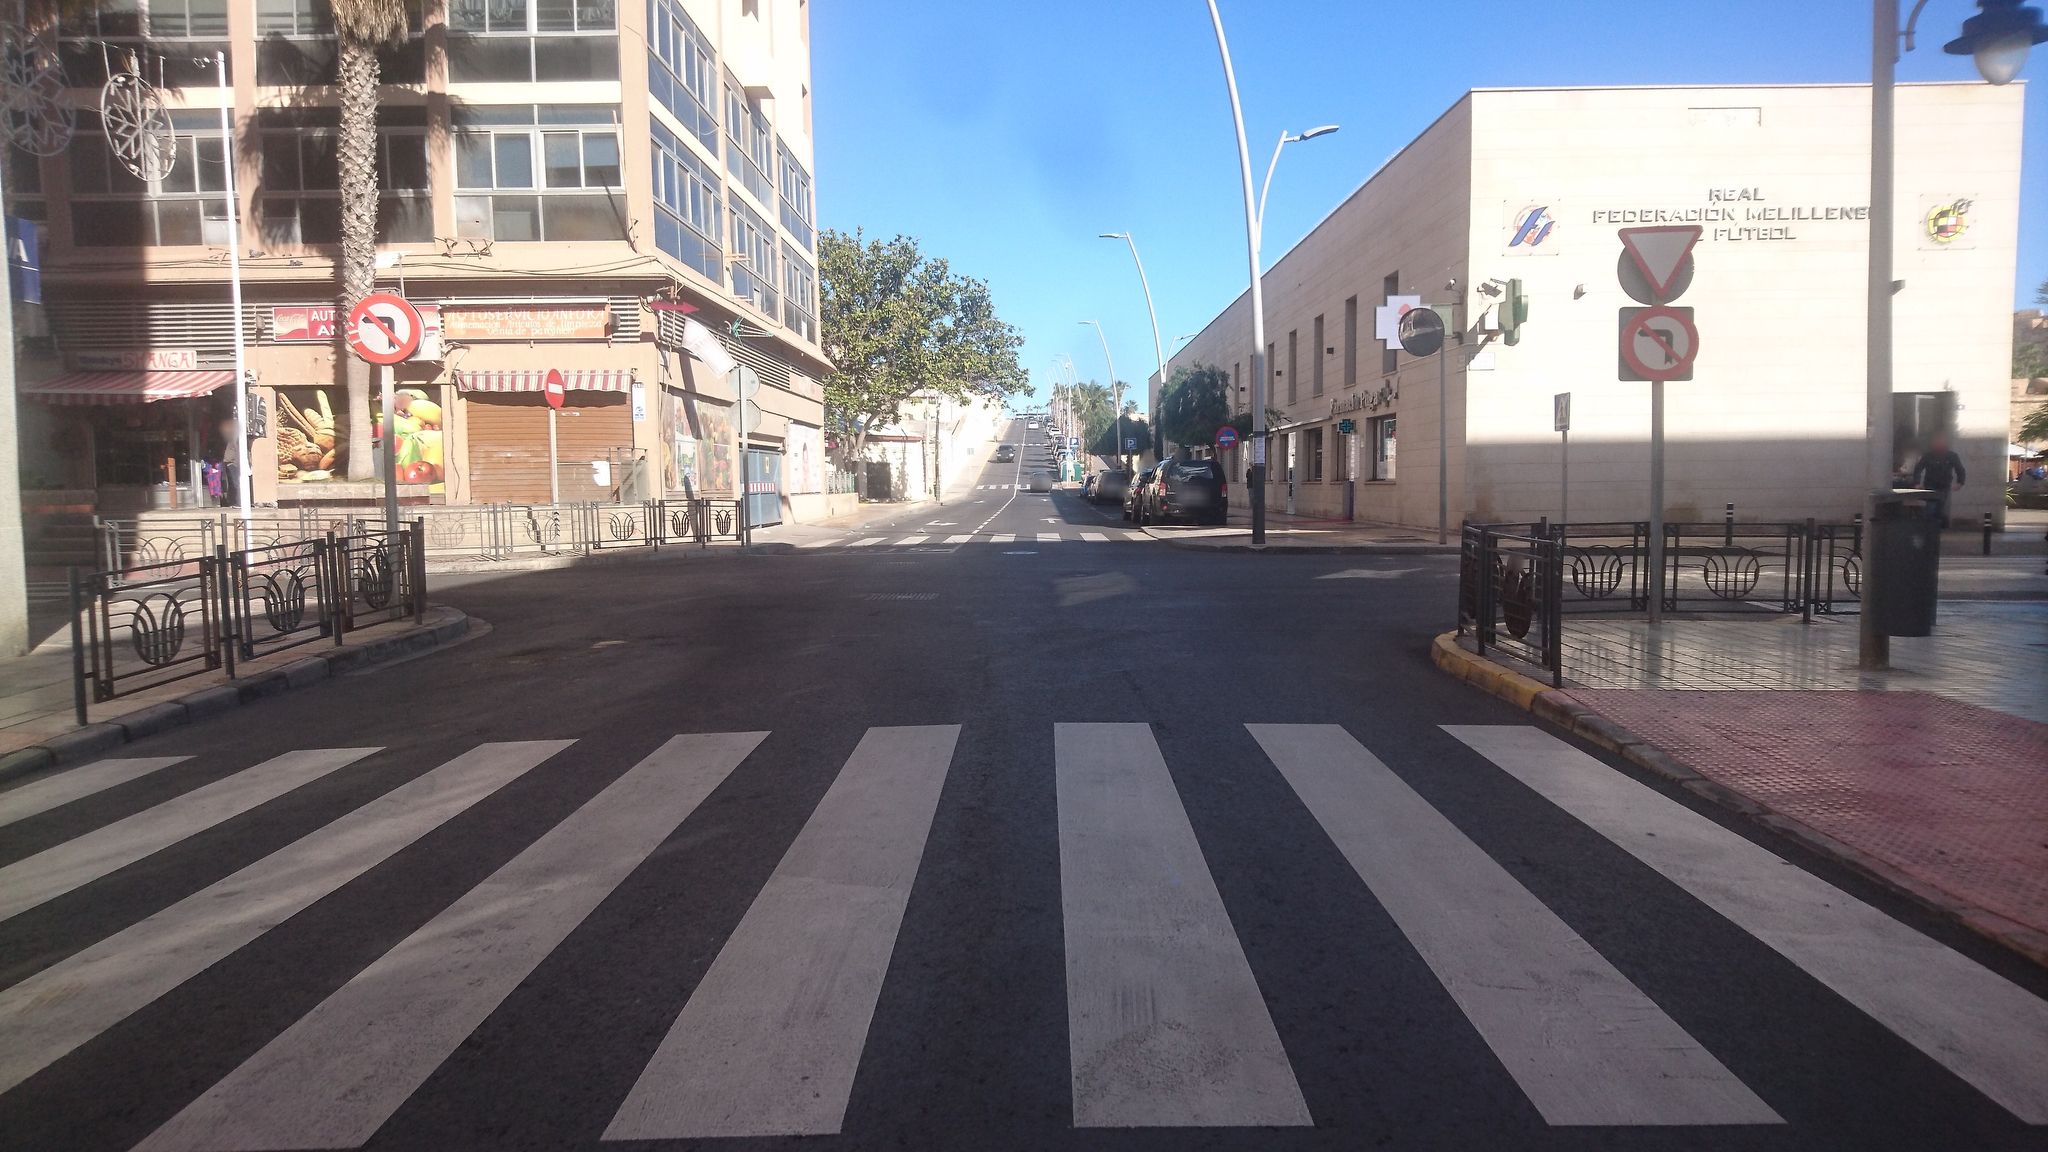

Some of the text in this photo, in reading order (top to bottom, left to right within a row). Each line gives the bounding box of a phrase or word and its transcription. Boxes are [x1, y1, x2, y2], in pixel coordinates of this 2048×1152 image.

[1708, 187, 1766, 202] REAL
[1746, 206, 1872, 222] MELILLENS
[1127, 439, 1135, 448] P
